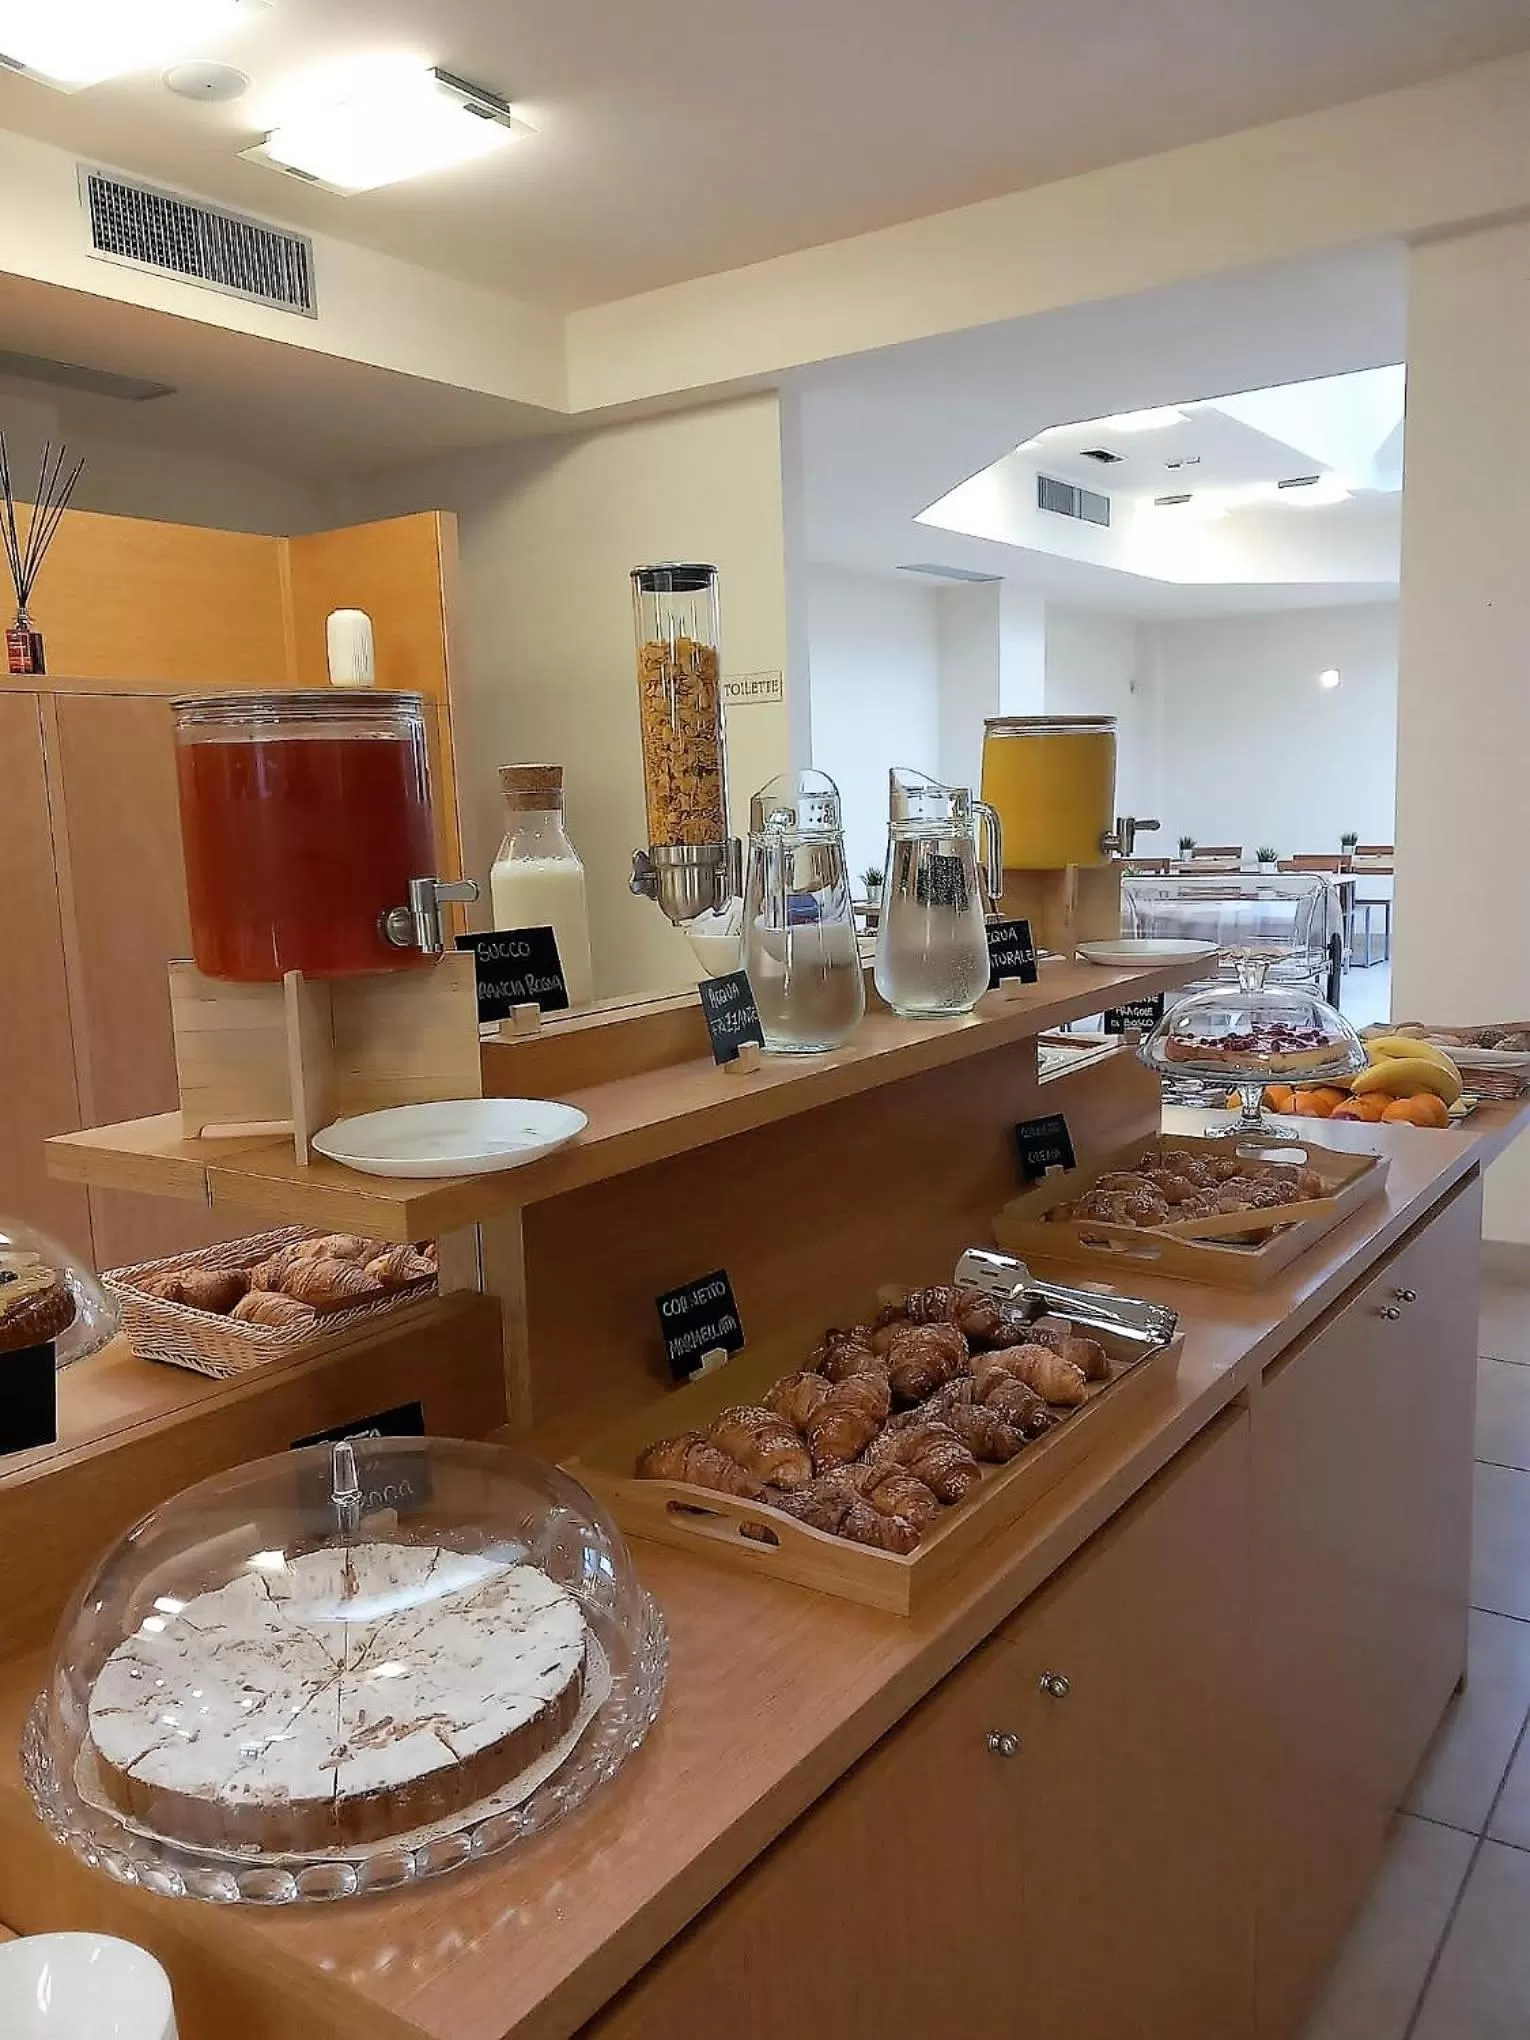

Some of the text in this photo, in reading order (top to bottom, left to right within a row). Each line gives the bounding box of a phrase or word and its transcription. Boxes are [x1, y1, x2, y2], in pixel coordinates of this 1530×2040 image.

[723, 680, 779, 696] TOILETTE
[478, 942, 531, 962] SUCCO
[479, 980, 526, 1000] RANCIA
[707, 982, 740, 1009] ACQUA
